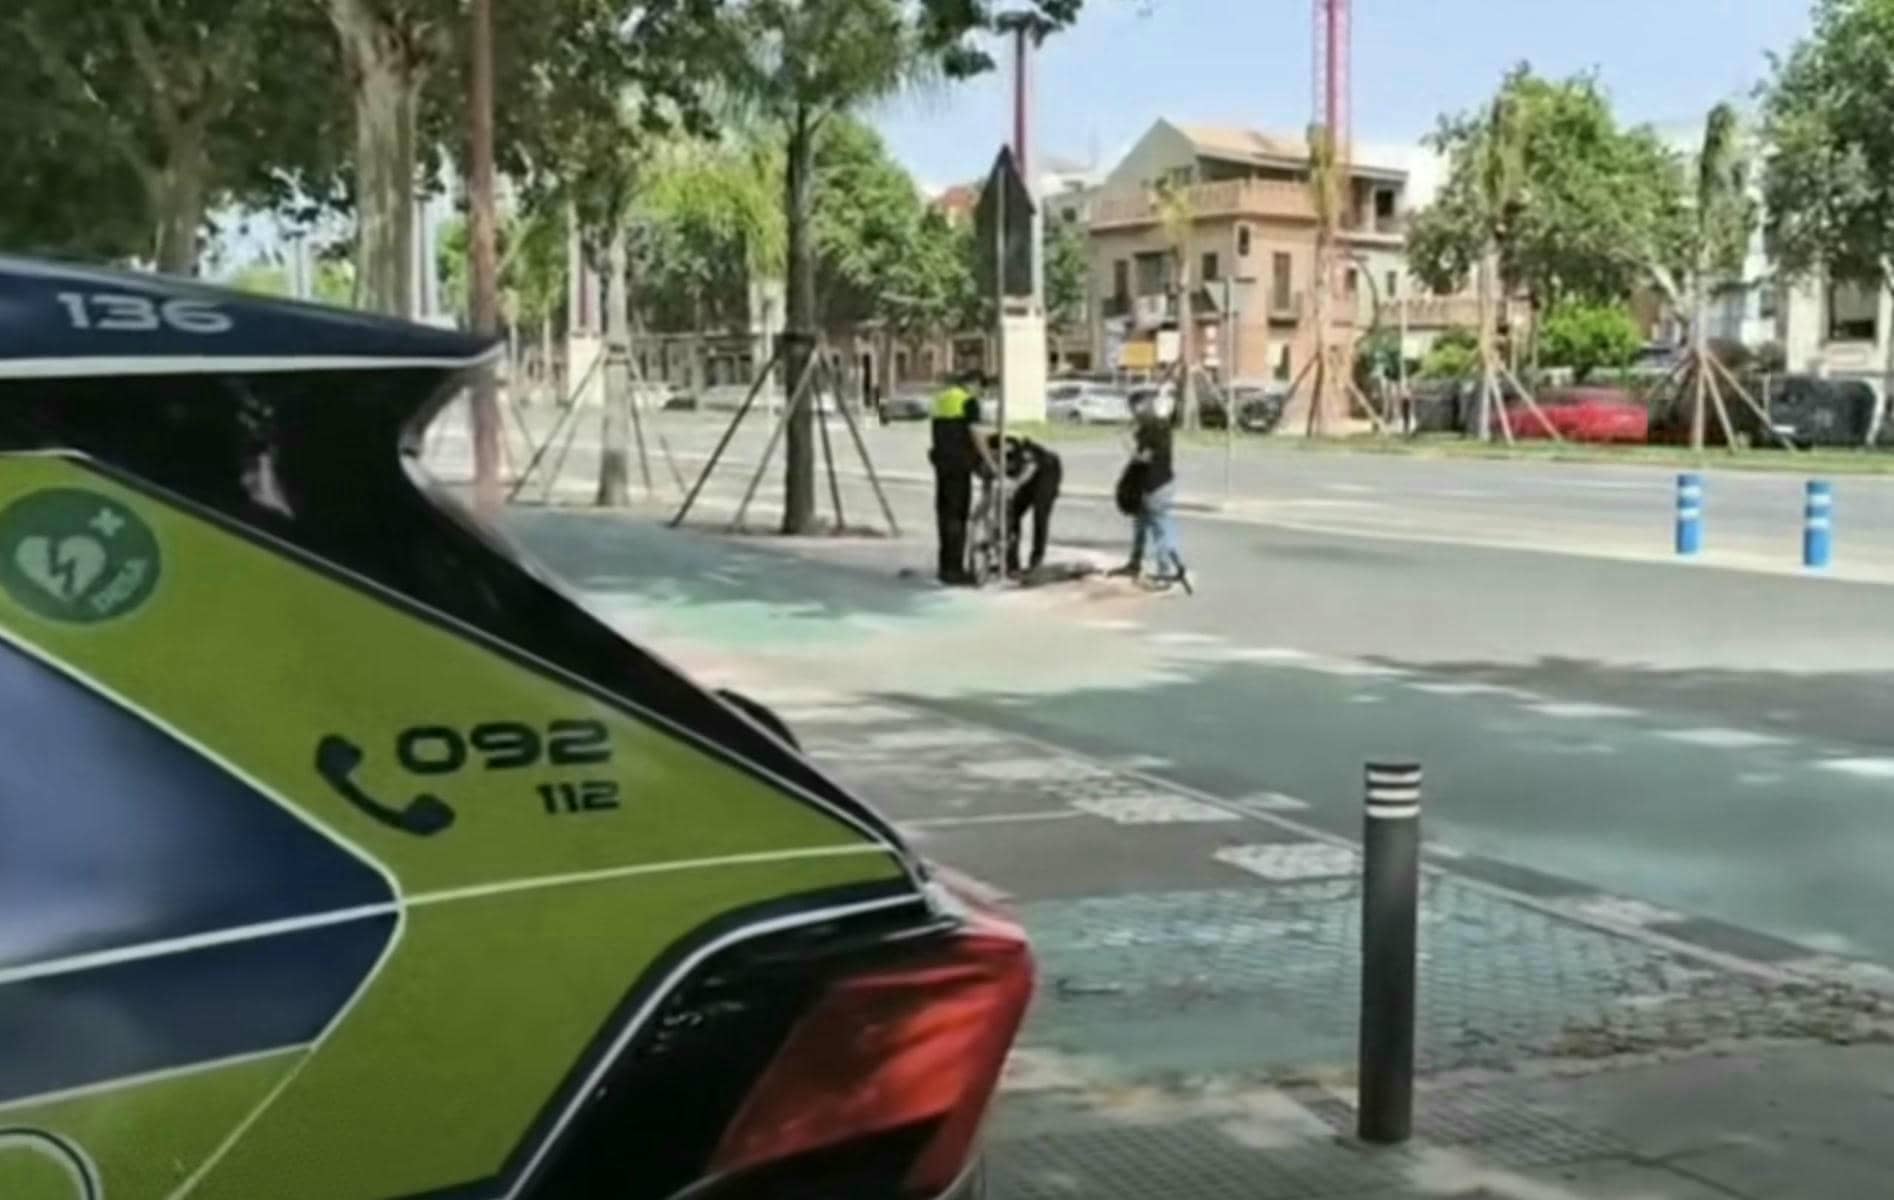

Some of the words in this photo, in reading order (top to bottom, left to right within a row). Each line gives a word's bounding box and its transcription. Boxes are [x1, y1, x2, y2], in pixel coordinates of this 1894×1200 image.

[57, 292, 233, 333] 136
[396, 719, 612, 775] 092
[536, 780, 620, 814] 112
